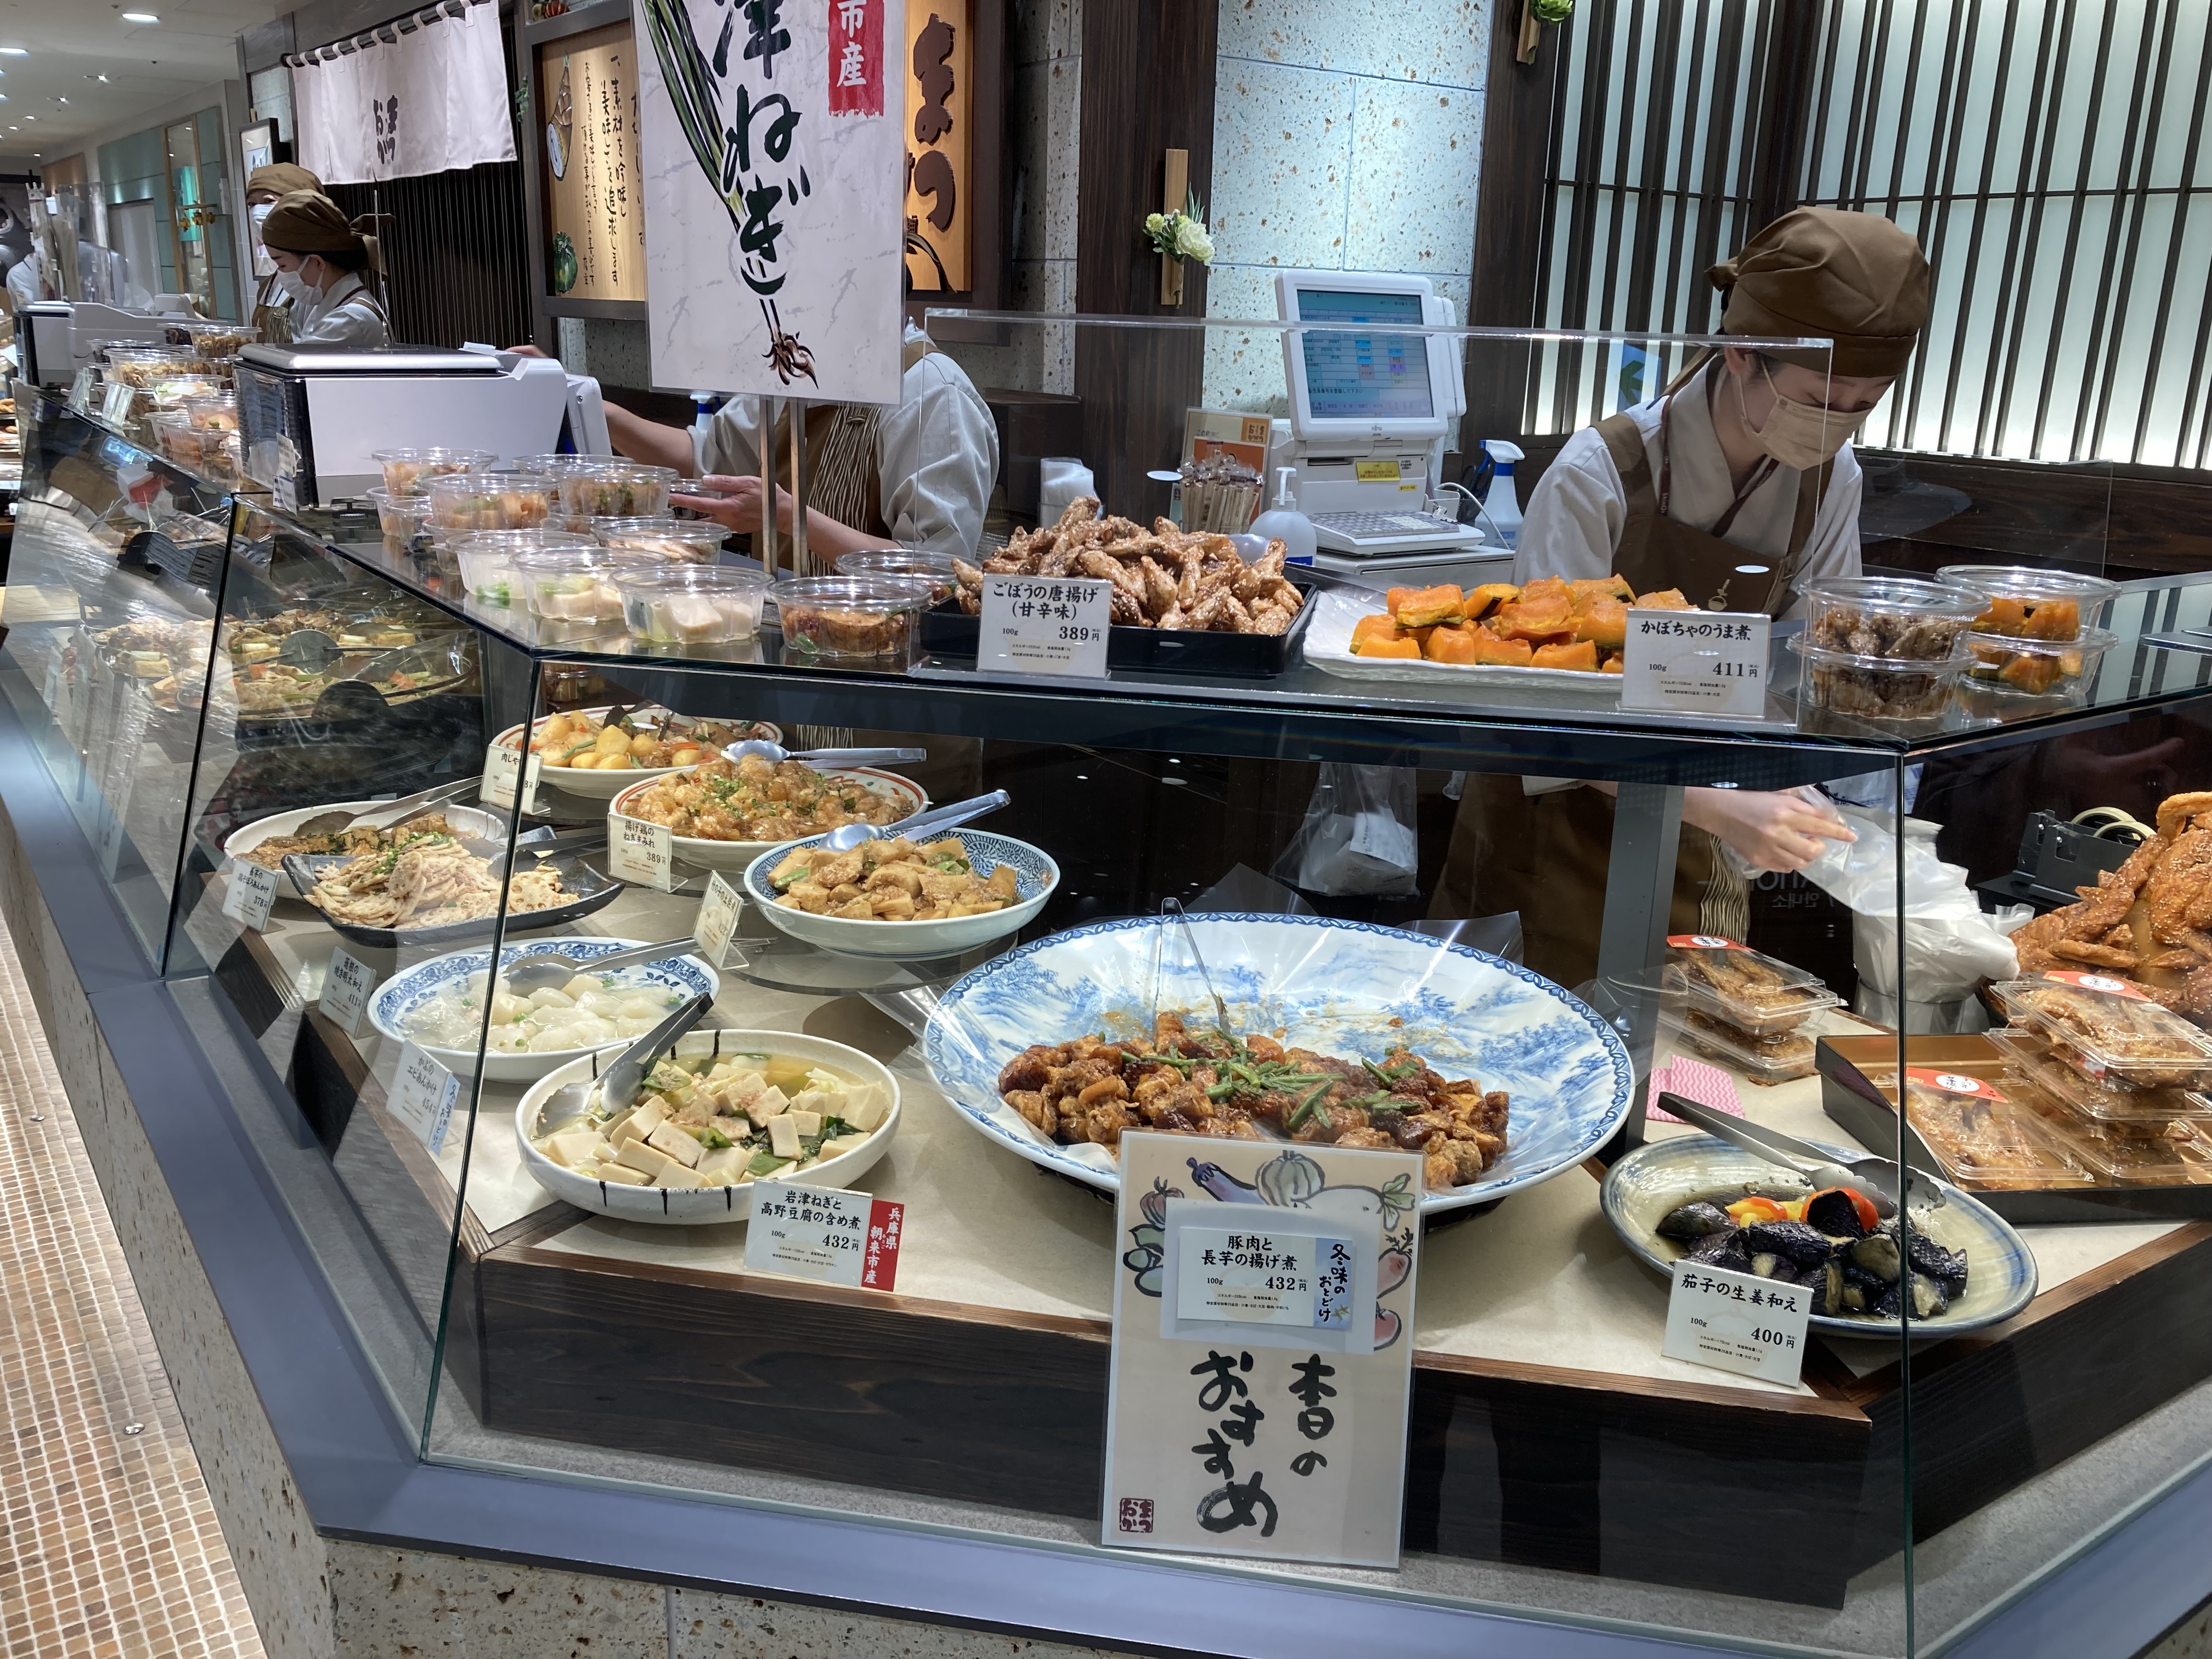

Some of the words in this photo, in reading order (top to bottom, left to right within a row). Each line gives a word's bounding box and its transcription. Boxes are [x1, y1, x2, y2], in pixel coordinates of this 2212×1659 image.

[994, 582, 1099, 604] ごぼうの唐揚げ
[1012, 601, 1077, 621] (甘辛味)
[1002, 628, 1018, 636] 100g
[1641, 620, 1752, 641] かぼちゃのうま煮
[1649, 663, 1667, 672] 100g
[625, 820, 654, 836] 揚げ鶏の
[623, 831, 656, 849] ねぎまみれ
[417, 1055, 435, 1076] かぶの
[407, 1065, 438, 1096] エビあんかけ
[784, 1190, 842, 1210] 岩津ねぎと
[761, 1201, 861, 1231] 高野豆腐の含め煮
[771, 1230, 786, 1239] 100g
[885, 1206, 901, 1251] 兵庫県
[864, 1224, 883, 1284] 朝来市産
[1227, 1235, 1273, 1252] 豚肉と
[1201, 1249, 1298, 1271] 長芋の揚げ煮
[1330, 1243, 1351, 1294] 冬味の
[1206, 1277, 1223, 1285] 100g
[1318, 1275, 1334, 1322] おとどけ
[1681, 1273, 1797, 1313] 茄子の生姜和え
[1690, 1317, 1708, 1328] 100g
[1288, 1353, 1338, 1477] 本日の
[1190, 1350, 1278, 1537] おすすめ
